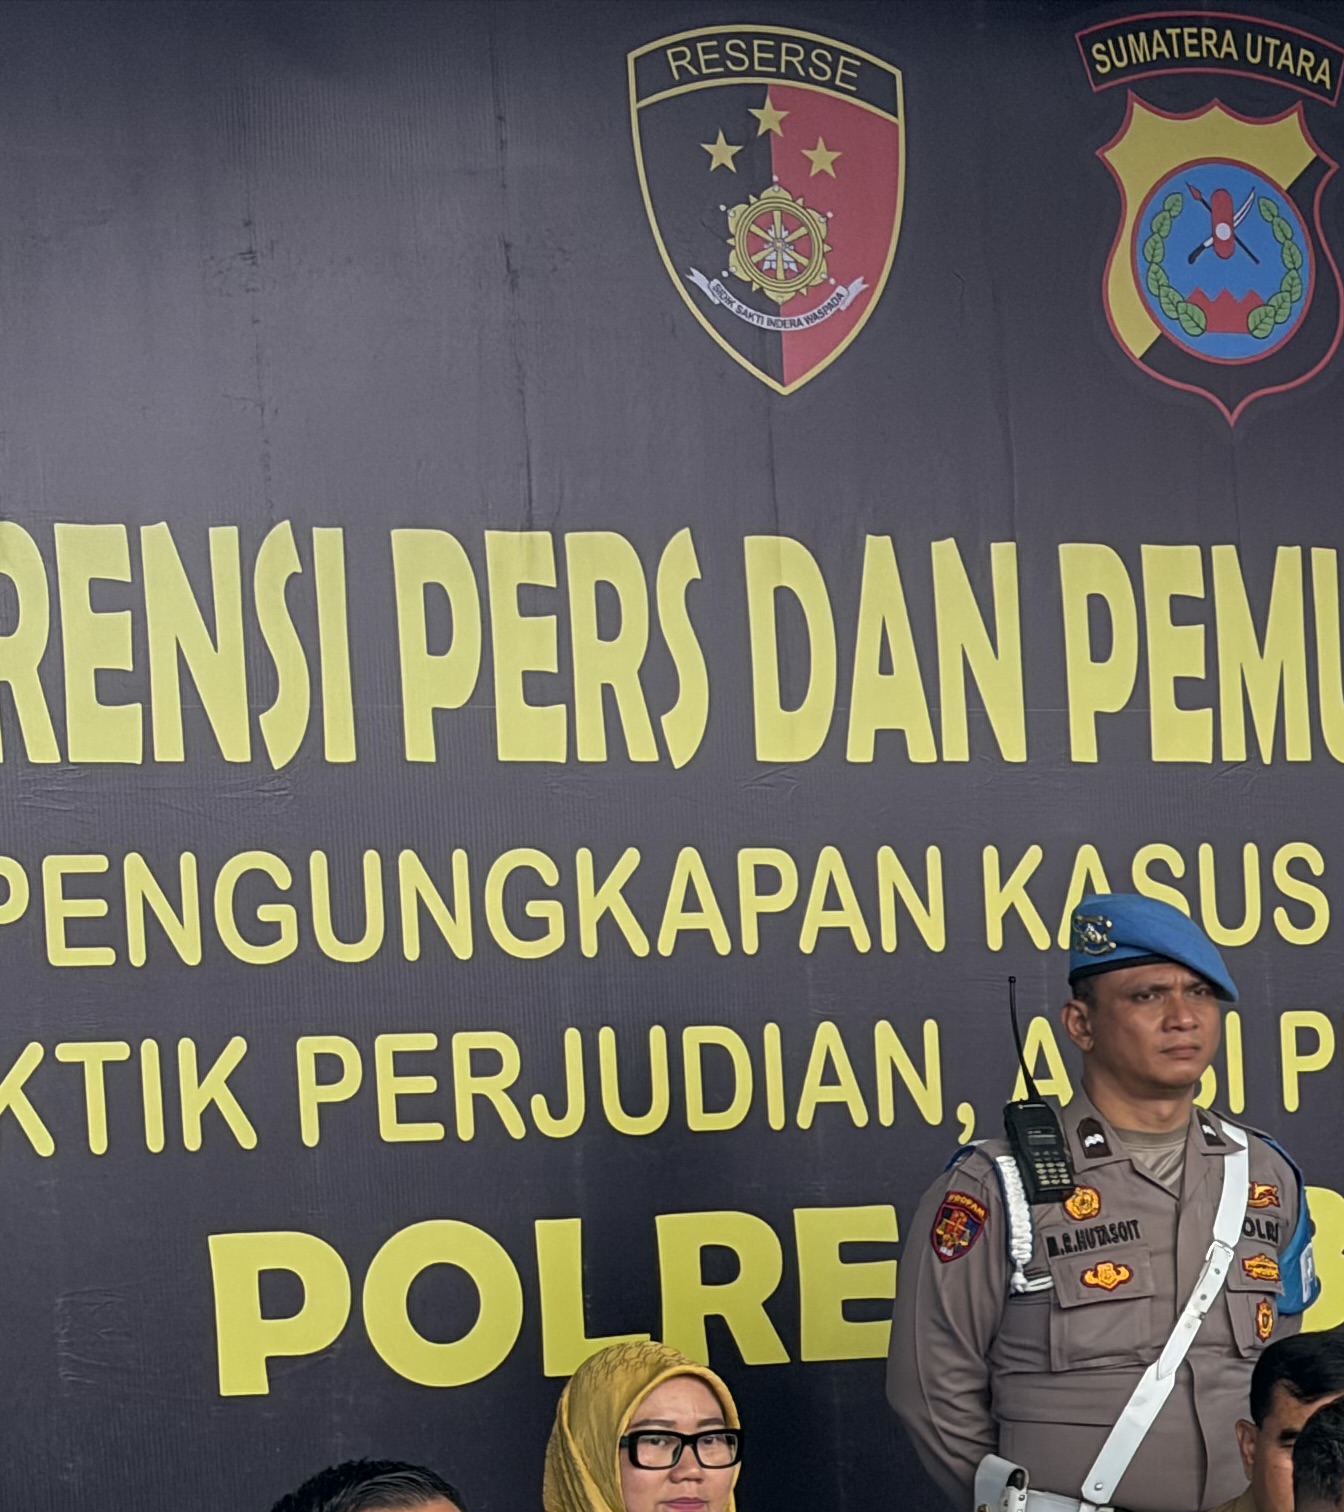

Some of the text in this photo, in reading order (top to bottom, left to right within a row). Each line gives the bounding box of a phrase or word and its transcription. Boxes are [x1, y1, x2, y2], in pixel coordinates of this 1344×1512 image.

[666, 38, 862, 92] RESERSE
[1091, 27, 1332, 91] SUMATERA UTARA
[711, 283, 846, 329] SIDIK SAKTI INDERA WASPADA
[0, 521, 357, 770] RENSI
[391, 528, 709, 769] PERS
[743, 535, 1027, 764] DAN
[983, 842, 1332, 952] KASUS
[296, 1019, 976, 1148] PERJUDIAN,
[1011, 1010, 1246, 1115] AI
[1242, 1215, 1279, 1244] OLRI
